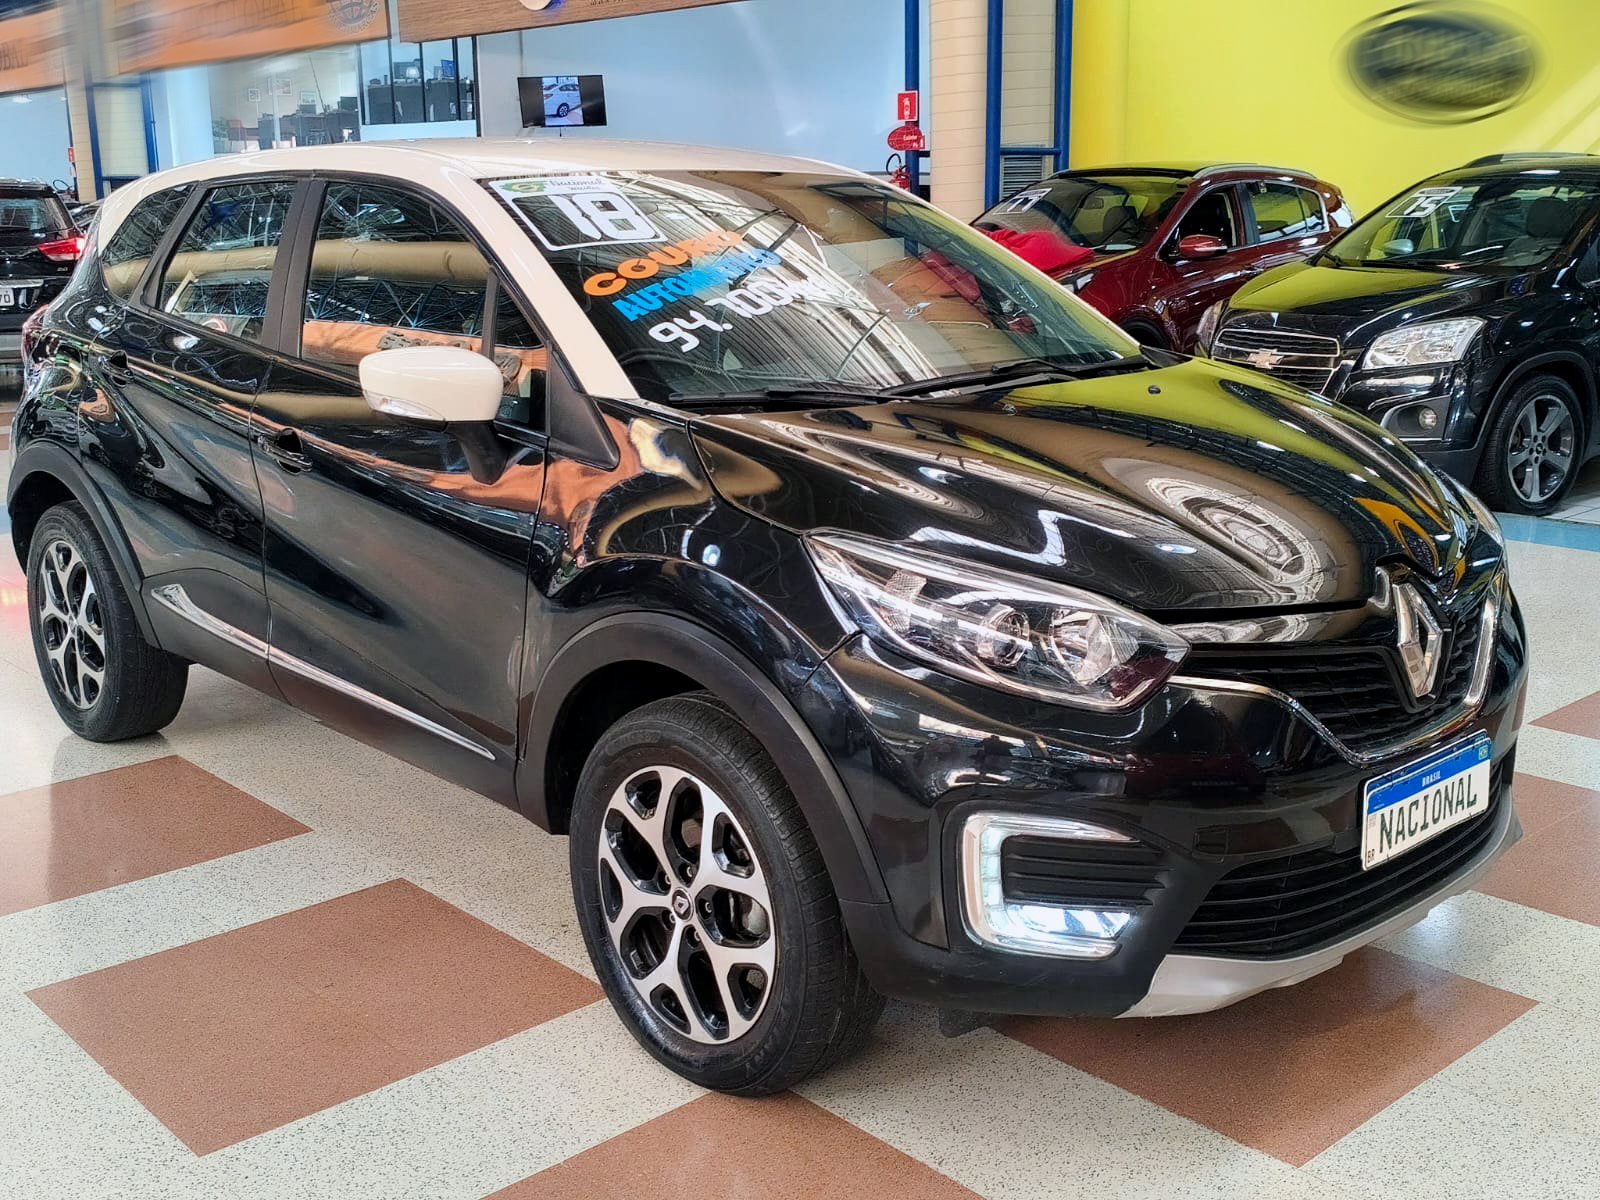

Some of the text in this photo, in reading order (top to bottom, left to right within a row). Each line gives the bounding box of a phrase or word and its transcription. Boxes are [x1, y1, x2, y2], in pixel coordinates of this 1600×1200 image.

[549, 193, 657, 241] 18
[1403, 196, 1446, 216] 15
[583, 230, 743, 296] COURO
[1421, 770, 1441, 787] BRASIL
[1379, 773, 1478, 854] NACIONAL
